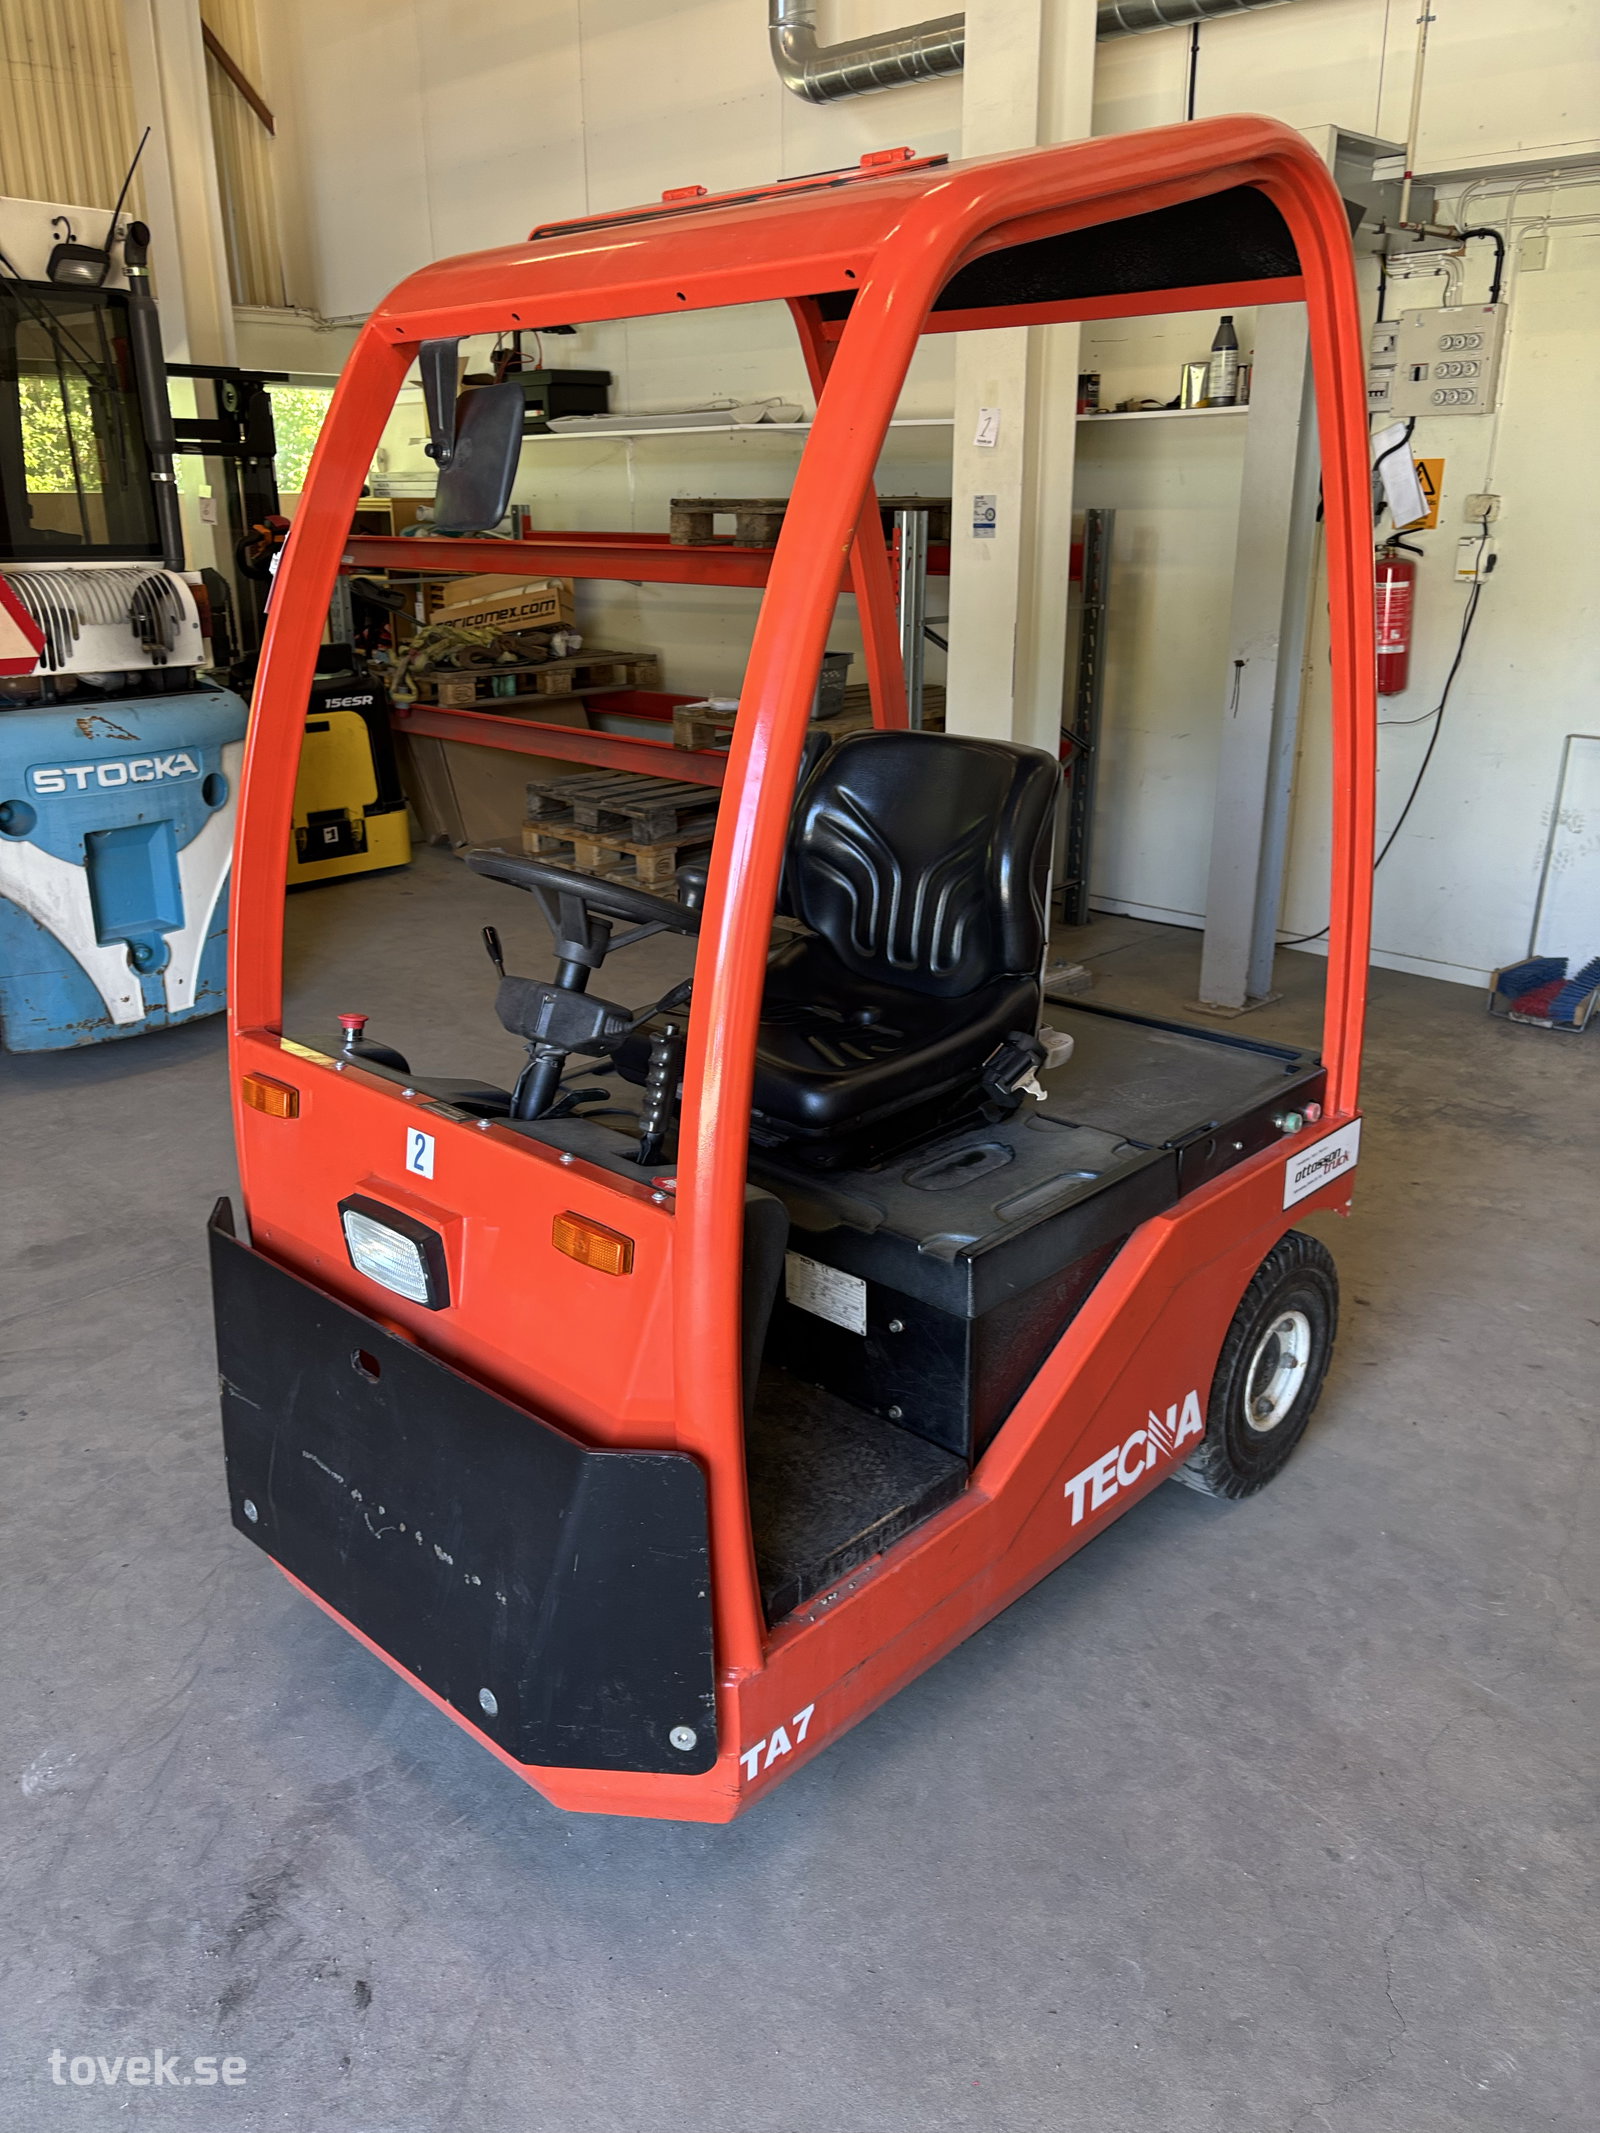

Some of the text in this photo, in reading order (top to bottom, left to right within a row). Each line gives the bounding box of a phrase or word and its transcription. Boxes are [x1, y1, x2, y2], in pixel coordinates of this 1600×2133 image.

[436, 600, 556, 628] ericomex.com
[325, 695, 374, 709] 15ESR
[32, 753, 199, 794] STOCKA
[414, 1133, 426, 1172] 2
[1294, 1148, 1342, 1184] ottosson
[1322, 1150, 1350, 1175] truck
[1064, 1389, 1203, 1527] TECNA
